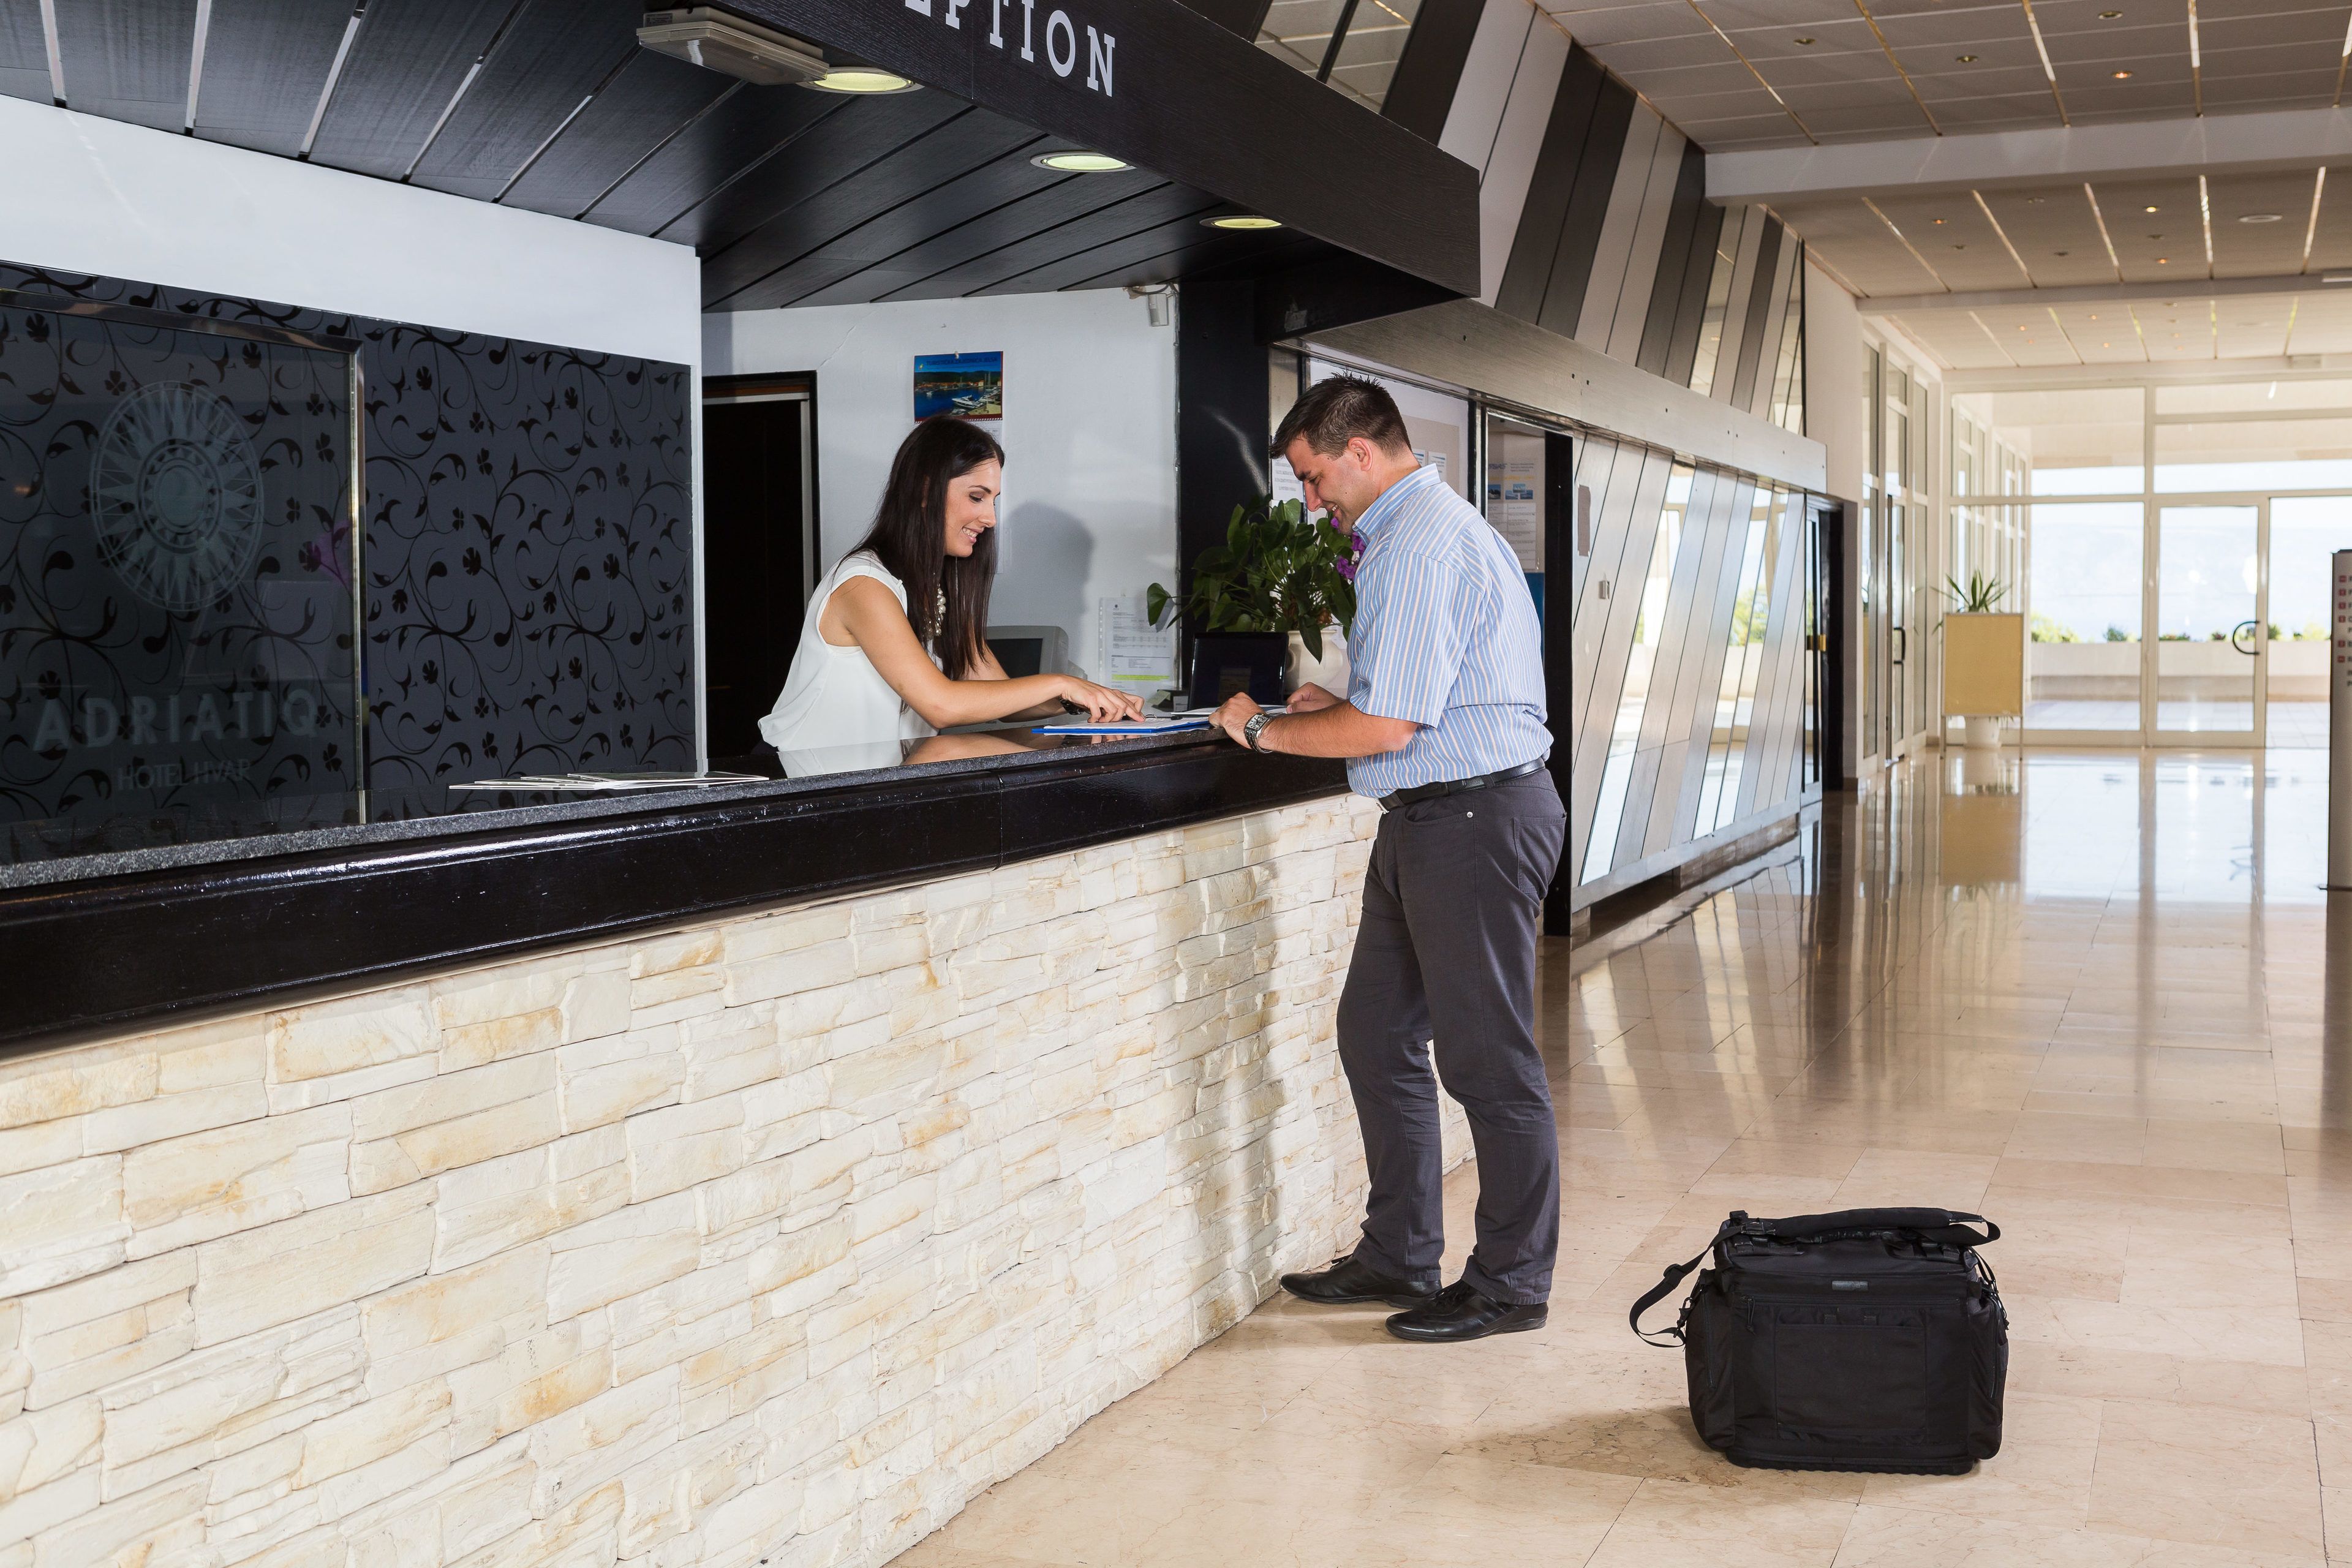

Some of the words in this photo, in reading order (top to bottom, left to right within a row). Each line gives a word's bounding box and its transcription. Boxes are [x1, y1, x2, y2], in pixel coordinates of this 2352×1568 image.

[905, 0, 1115, 97] TION
[32, 689, 318, 751] ADRIATIQ
[118, 764, 189, 791] HOTEL
